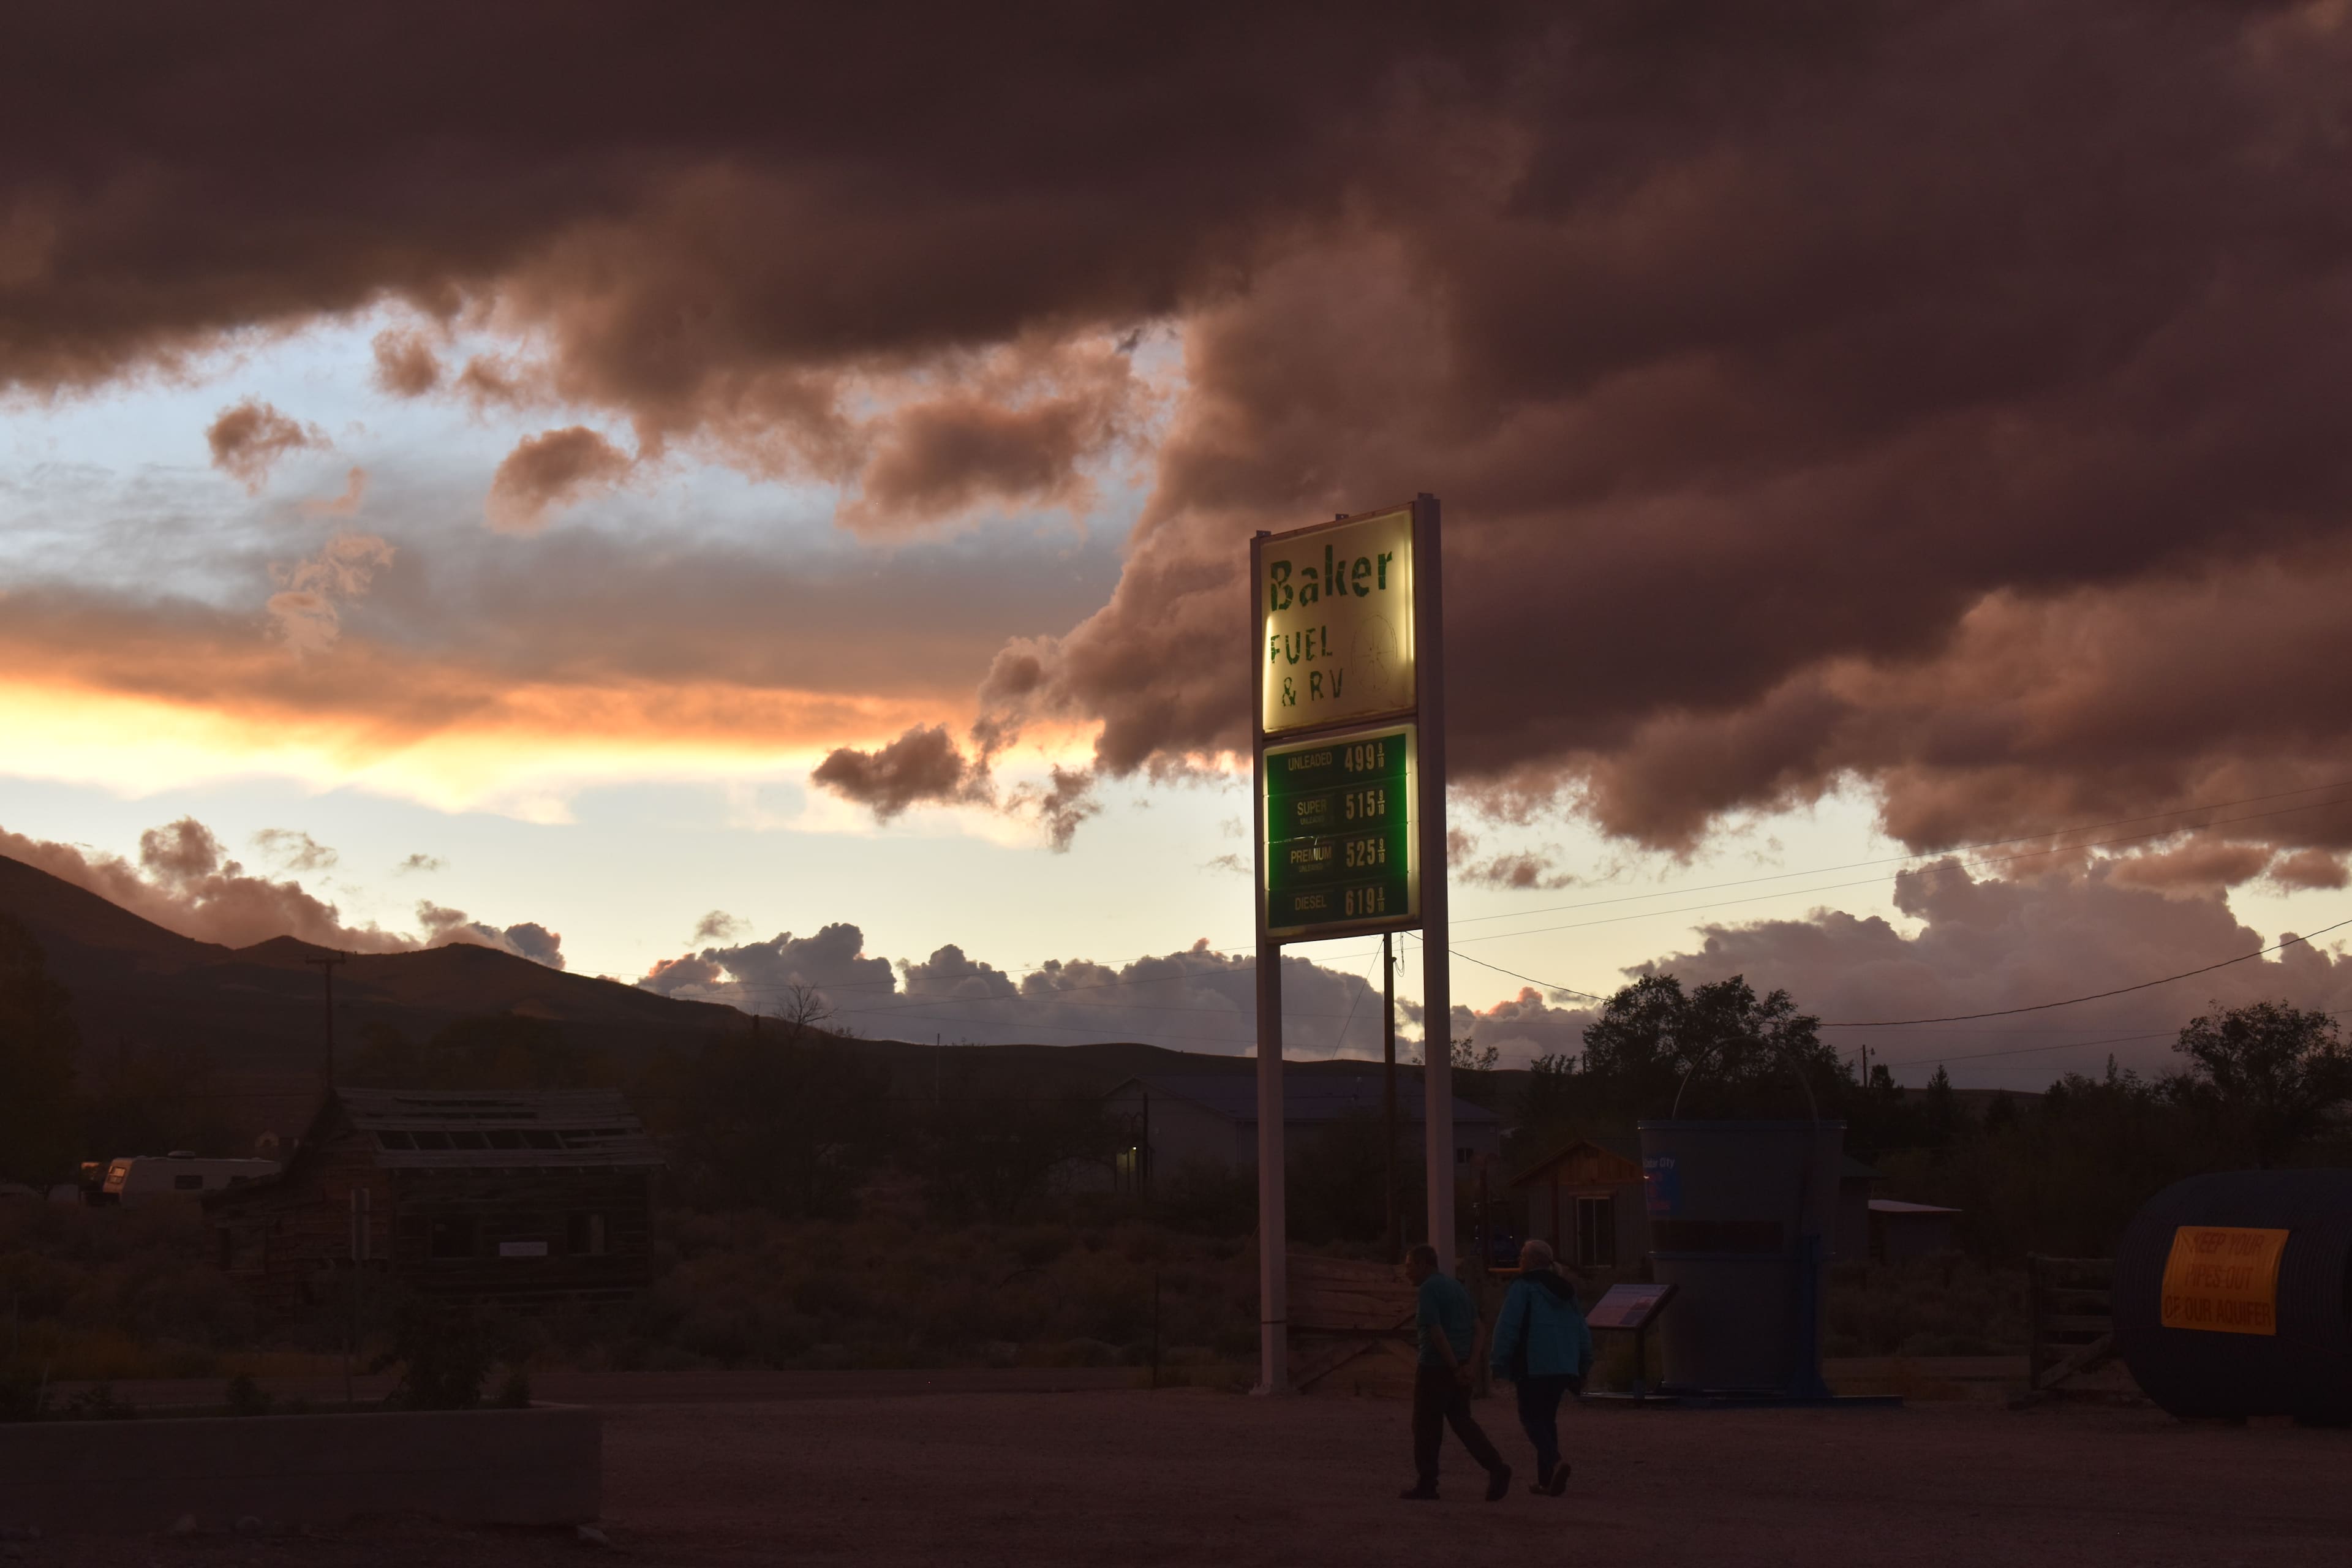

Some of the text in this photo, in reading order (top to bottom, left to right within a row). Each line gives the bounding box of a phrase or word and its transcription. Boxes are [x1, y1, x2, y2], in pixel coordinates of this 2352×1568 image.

[1270, 544, 1392, 611] Baker
[1270, 625, 1333, 665] FUEL
[1282, 668, 1343, 707] & RV
[1288, 743, 1375, 772] UNLEADED 499
[1297, 790, 1376, 820] SUPER 515
[1300, 815, 1325, 825] UNLEADED
[1290, 839, 1376, 868] PREMIUM 525
[1294, 887, 1375, 917] DIESEL 619
[2192, 1231, 2265, 1256] KEEP YOUR
[2185, 1264, 2255, 1289] PIPES OUT
[2165, 1295, 2272, 1327] OF OUR AQUIFER
